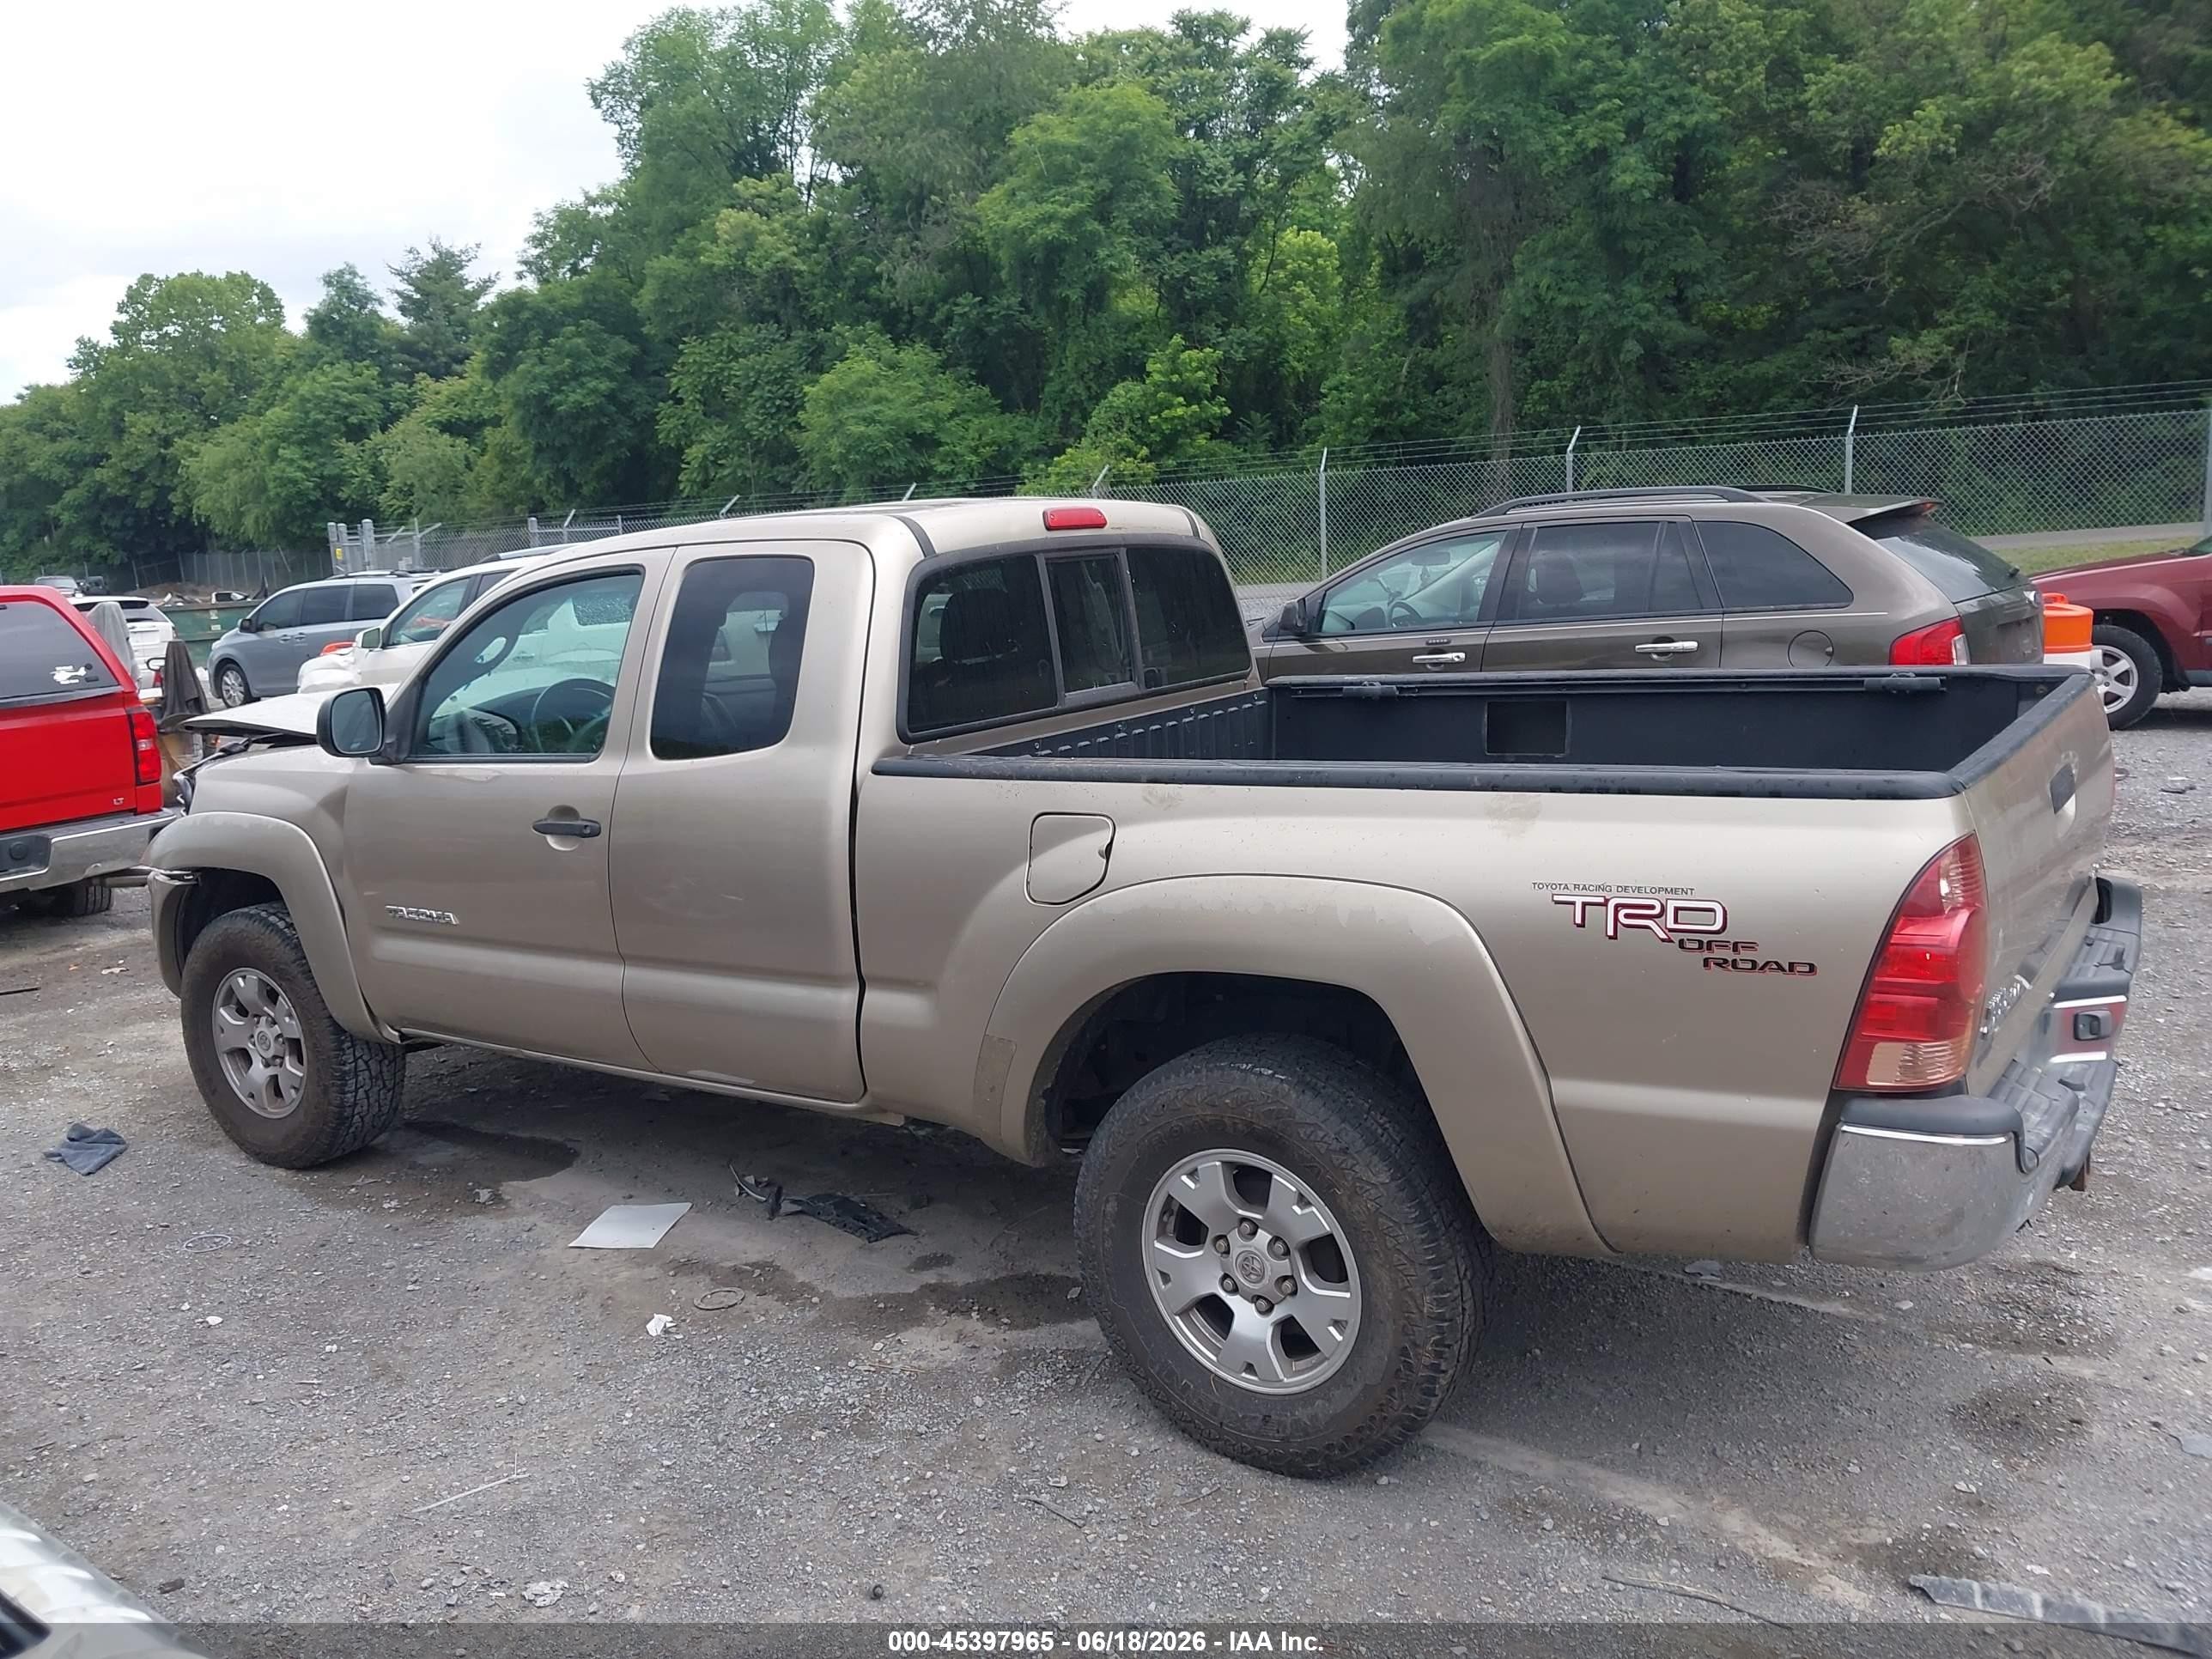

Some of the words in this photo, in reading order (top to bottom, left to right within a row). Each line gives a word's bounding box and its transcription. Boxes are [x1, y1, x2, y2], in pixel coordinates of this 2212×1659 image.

[112, 797, 125, 805] LT
[1532, 882, 1571, 893] TOYOTA
[1573, 884, 1613, 893] RACING
[1616, 885, 1695, 896] DEVELOPMENT
[1552, 893, 1728, 943] TRD
[1678, 938, 1759, 954] OFF
[1703, 957, 1817, 975] ROAD
